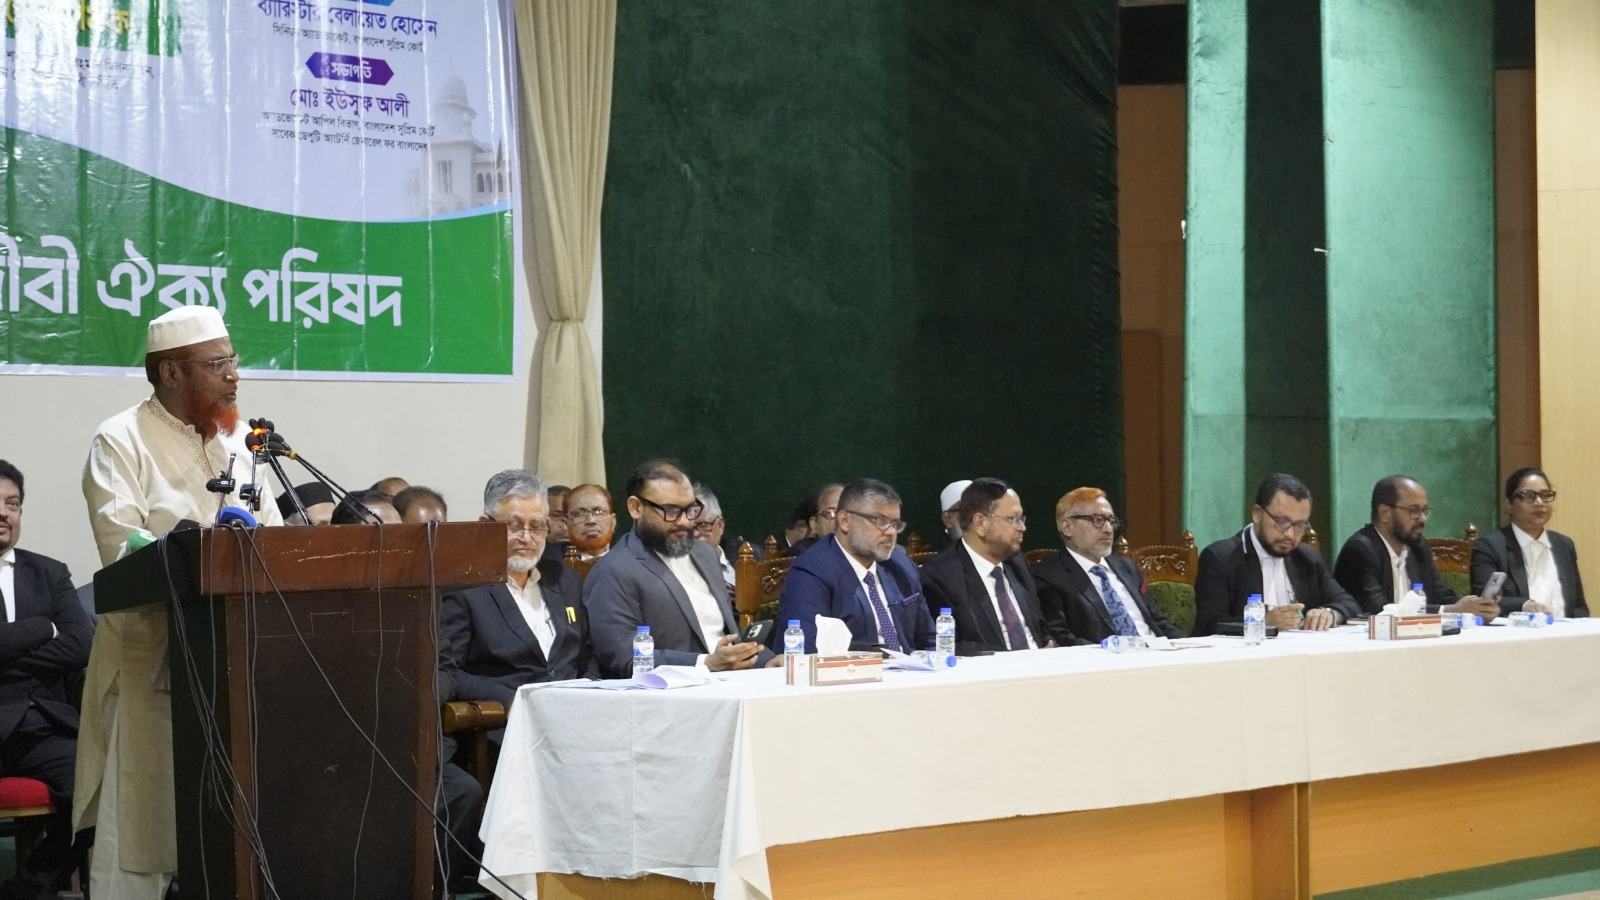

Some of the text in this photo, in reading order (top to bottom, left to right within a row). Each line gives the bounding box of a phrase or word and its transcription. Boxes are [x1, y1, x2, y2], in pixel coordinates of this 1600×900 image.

[331, 61, 373, 80] সভাপতি
[376, 93, 411, 118] আলী
[242, 247, 404, 329] পরিষদ
